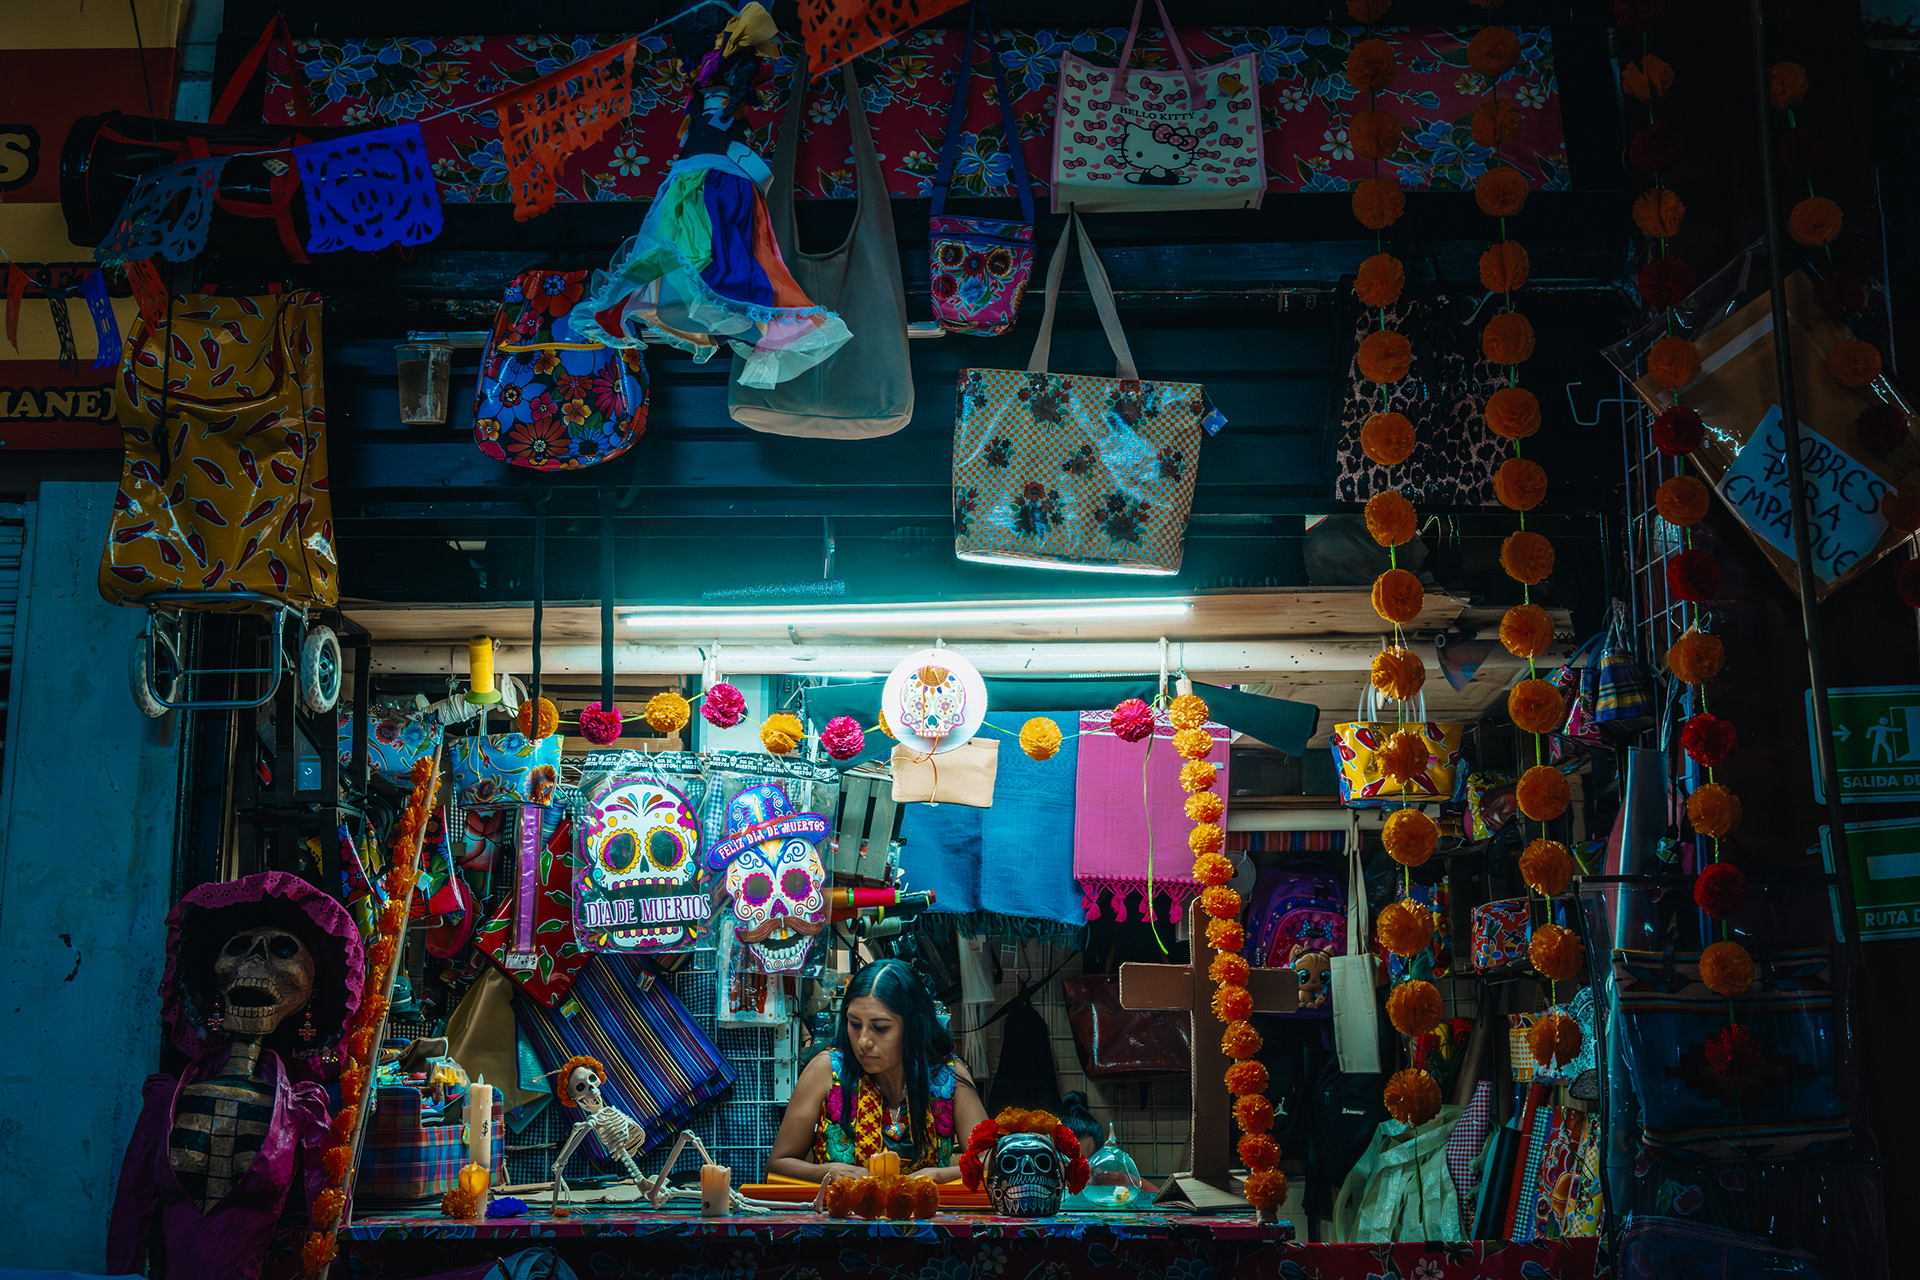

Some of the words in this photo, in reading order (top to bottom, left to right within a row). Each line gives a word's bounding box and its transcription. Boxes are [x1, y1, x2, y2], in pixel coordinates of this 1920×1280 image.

[1120, 106, 1157, 119] HELLO
[1160, 111, 1196, 121] KITTY
[1842, 775, 1899, 789] SALIDA
[766, 824, 780, 838] DE
[781, 820, 826, 834] MUERTOS
[640, 894, 711, 923] MUERTOS
[1865, 910, 1909, 928] RUTA
